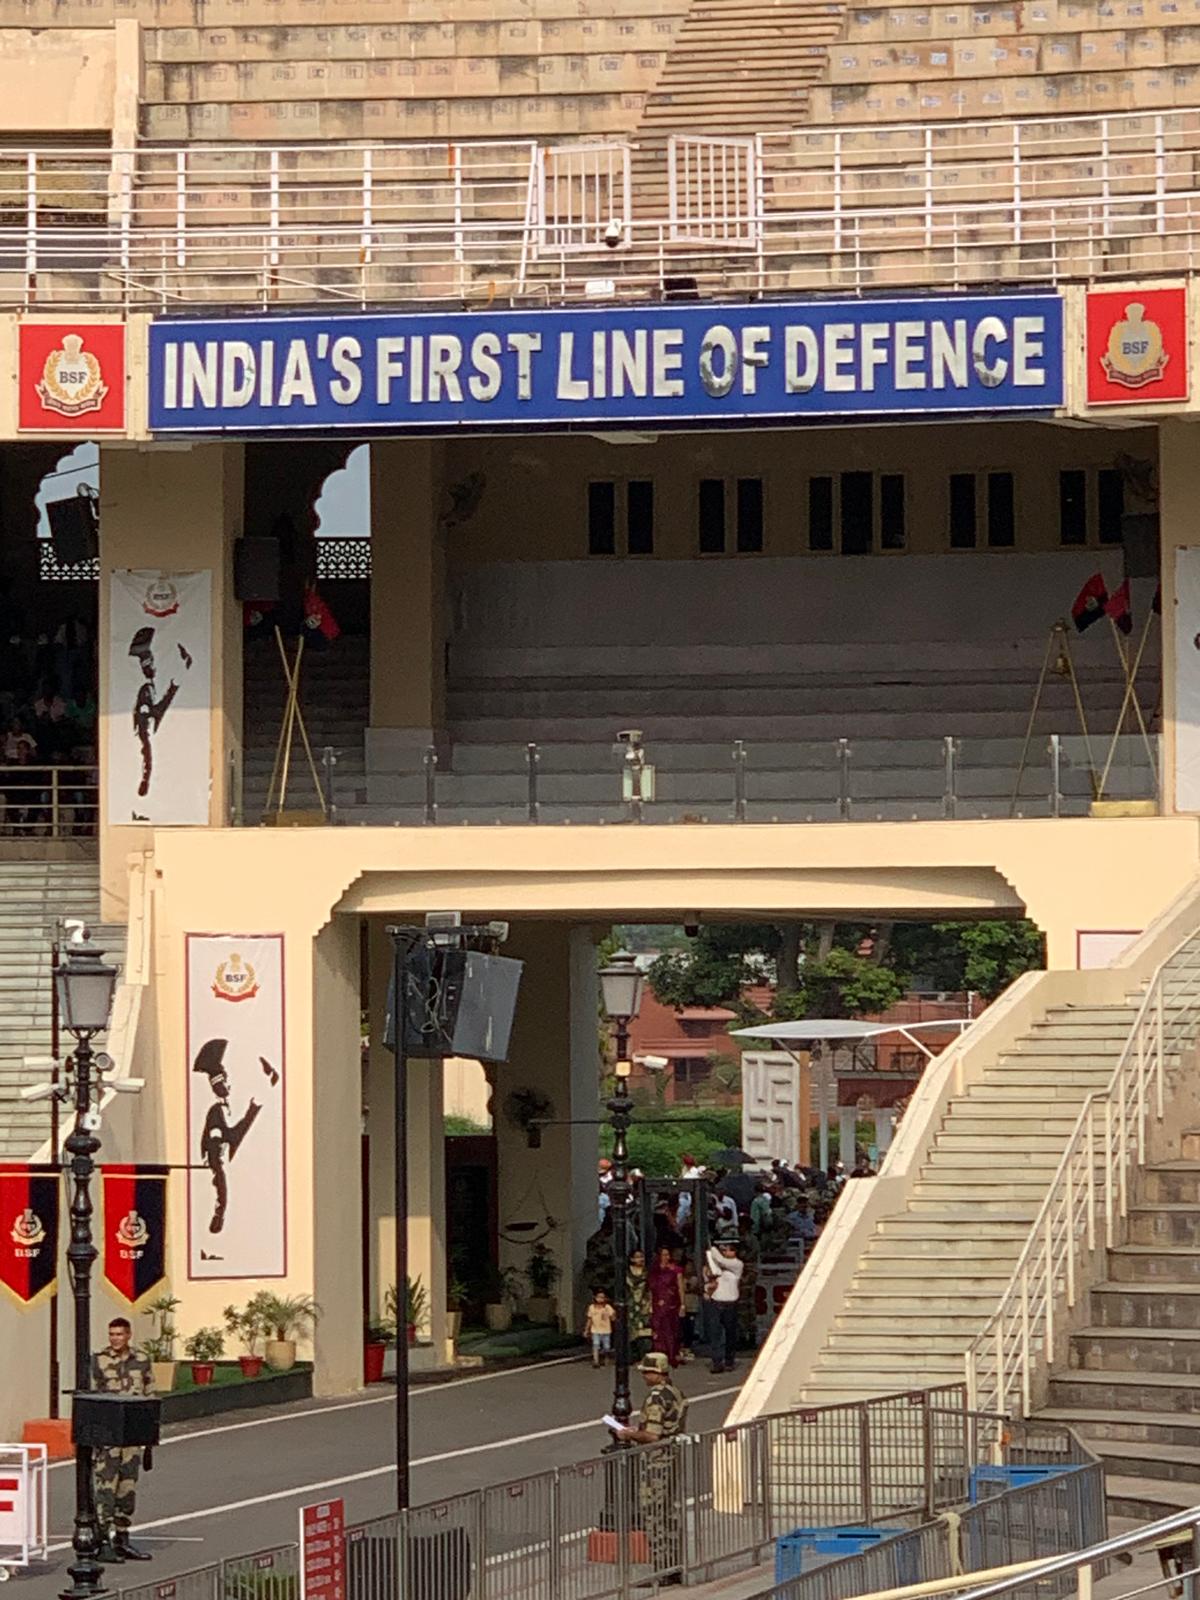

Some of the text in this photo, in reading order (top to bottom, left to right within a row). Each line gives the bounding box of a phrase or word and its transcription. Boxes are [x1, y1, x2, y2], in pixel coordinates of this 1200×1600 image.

[1121, 341, 1149, 355] BSF
[163, 315, 1046, 410] INDIA'S FIRST LINE OF DEFENCE
[59, 371, 87, 384] BSF
[225, 974, 247, 982] BSF
